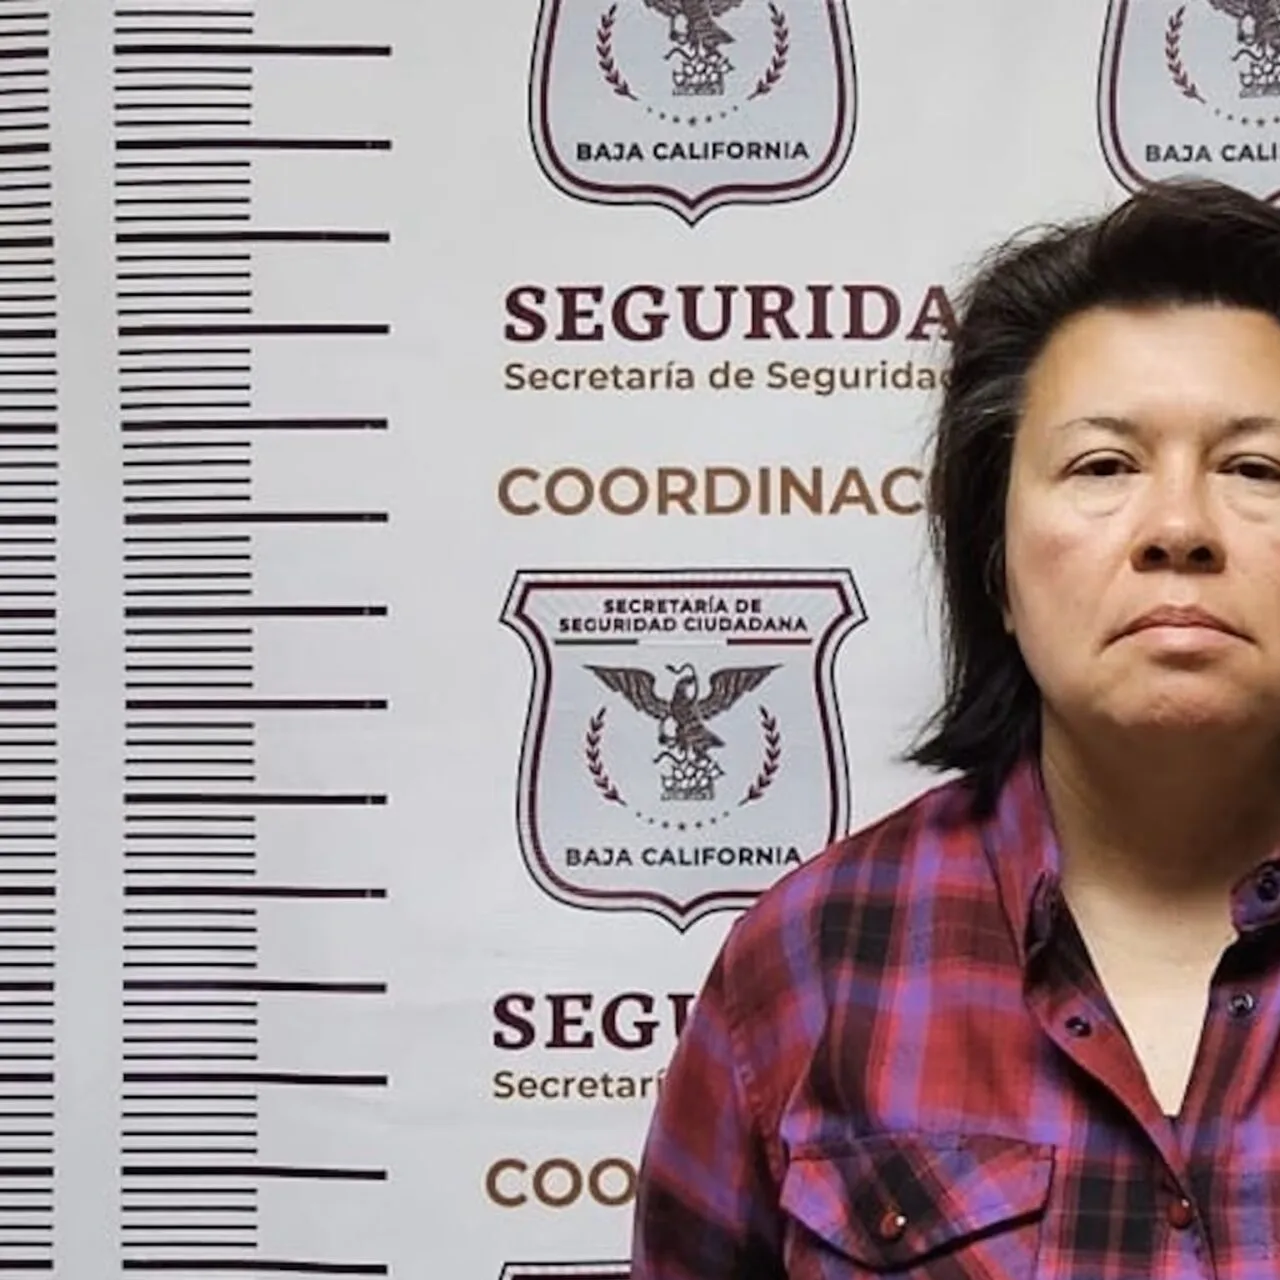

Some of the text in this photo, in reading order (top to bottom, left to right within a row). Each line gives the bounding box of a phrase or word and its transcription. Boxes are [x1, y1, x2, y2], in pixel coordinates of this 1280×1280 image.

[576, 141, 810, 162] BAJA CALIFORNIA
[1145, 144, 1213, 163] BAJA
[504, 360, 695, 391] Secretaría
[708, 360, 755, 391] de
[603, 594, 762, 615] SECRETARÍA DE
[559, 616, 808, 634] SEGURIDAD CIUDADANA
[565, 844, 801, 868] BAJA CALIFORNIA
